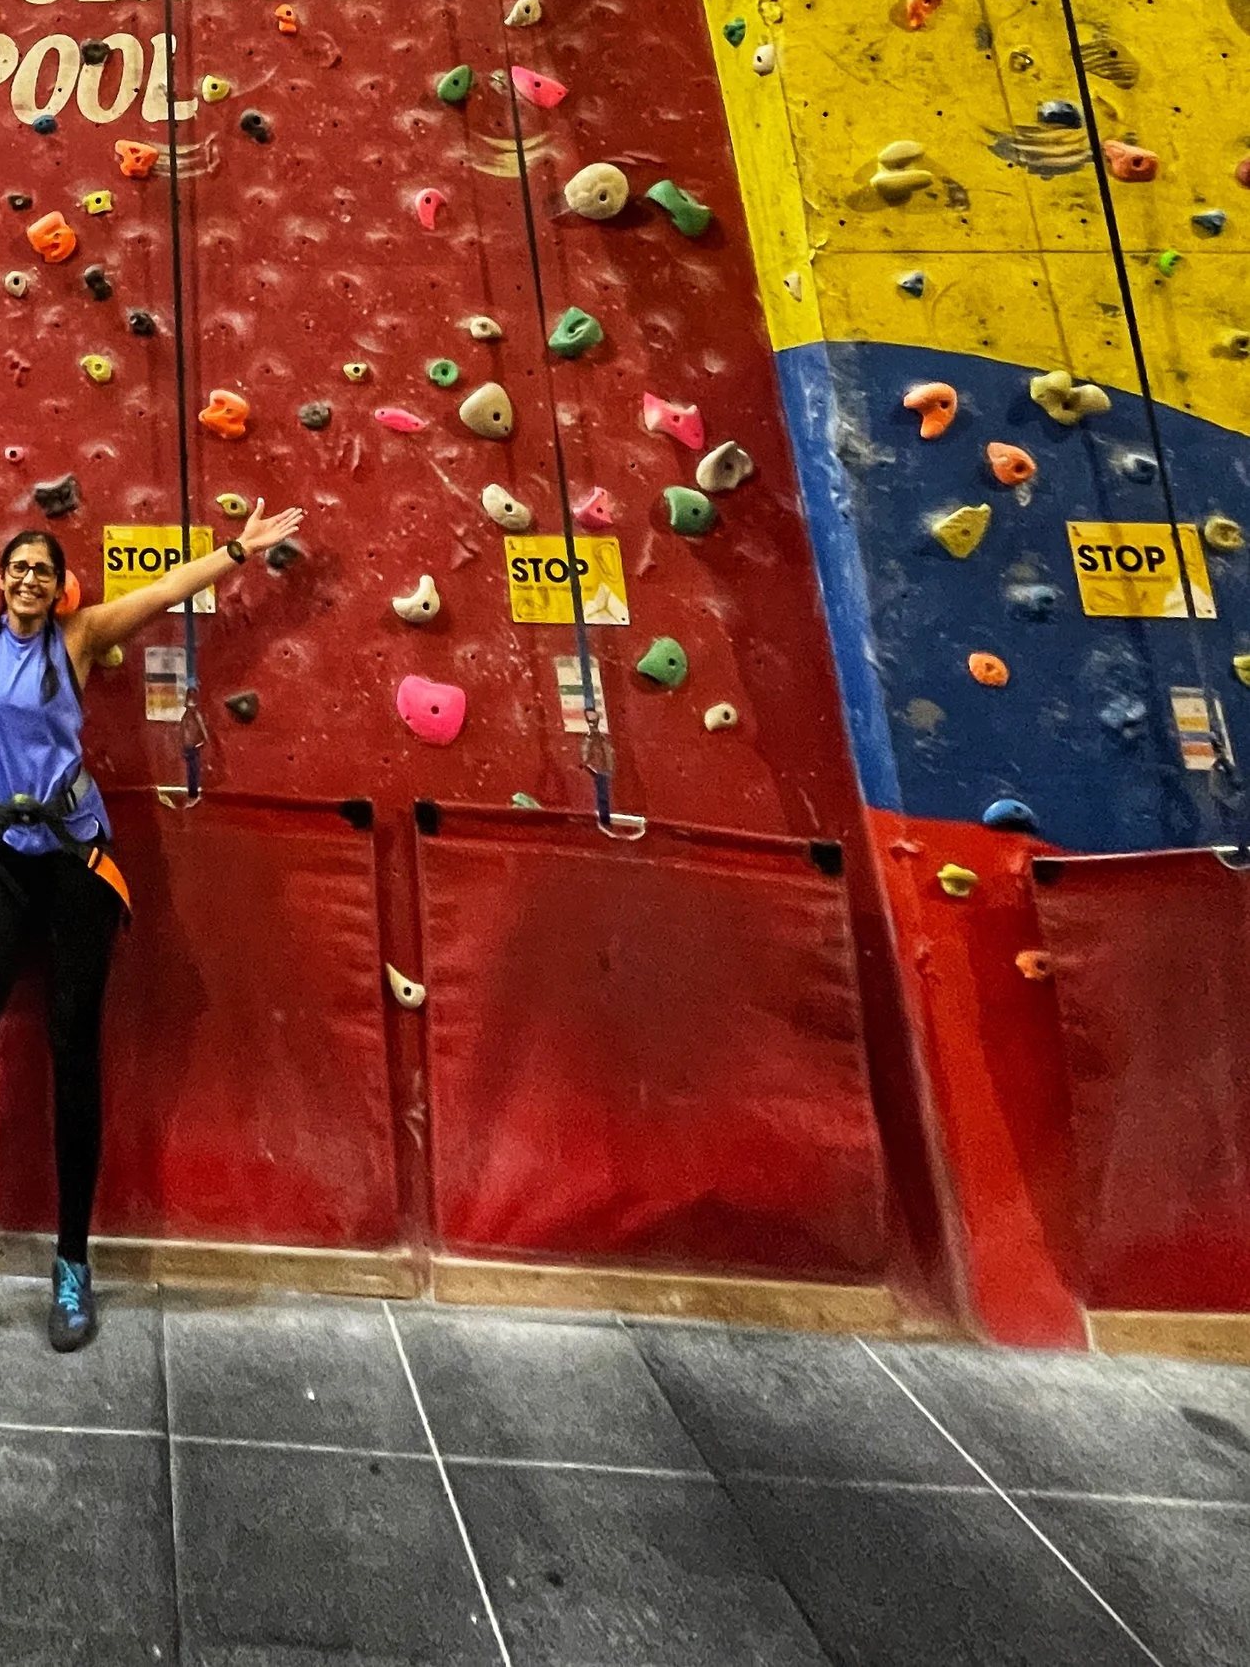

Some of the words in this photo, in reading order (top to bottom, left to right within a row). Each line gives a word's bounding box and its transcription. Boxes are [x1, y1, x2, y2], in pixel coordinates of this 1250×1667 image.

[107, 546, 181, 572] STOP
[511, 557, 589, 583] STOP
[1077, 544, 1166, 573] STOP
